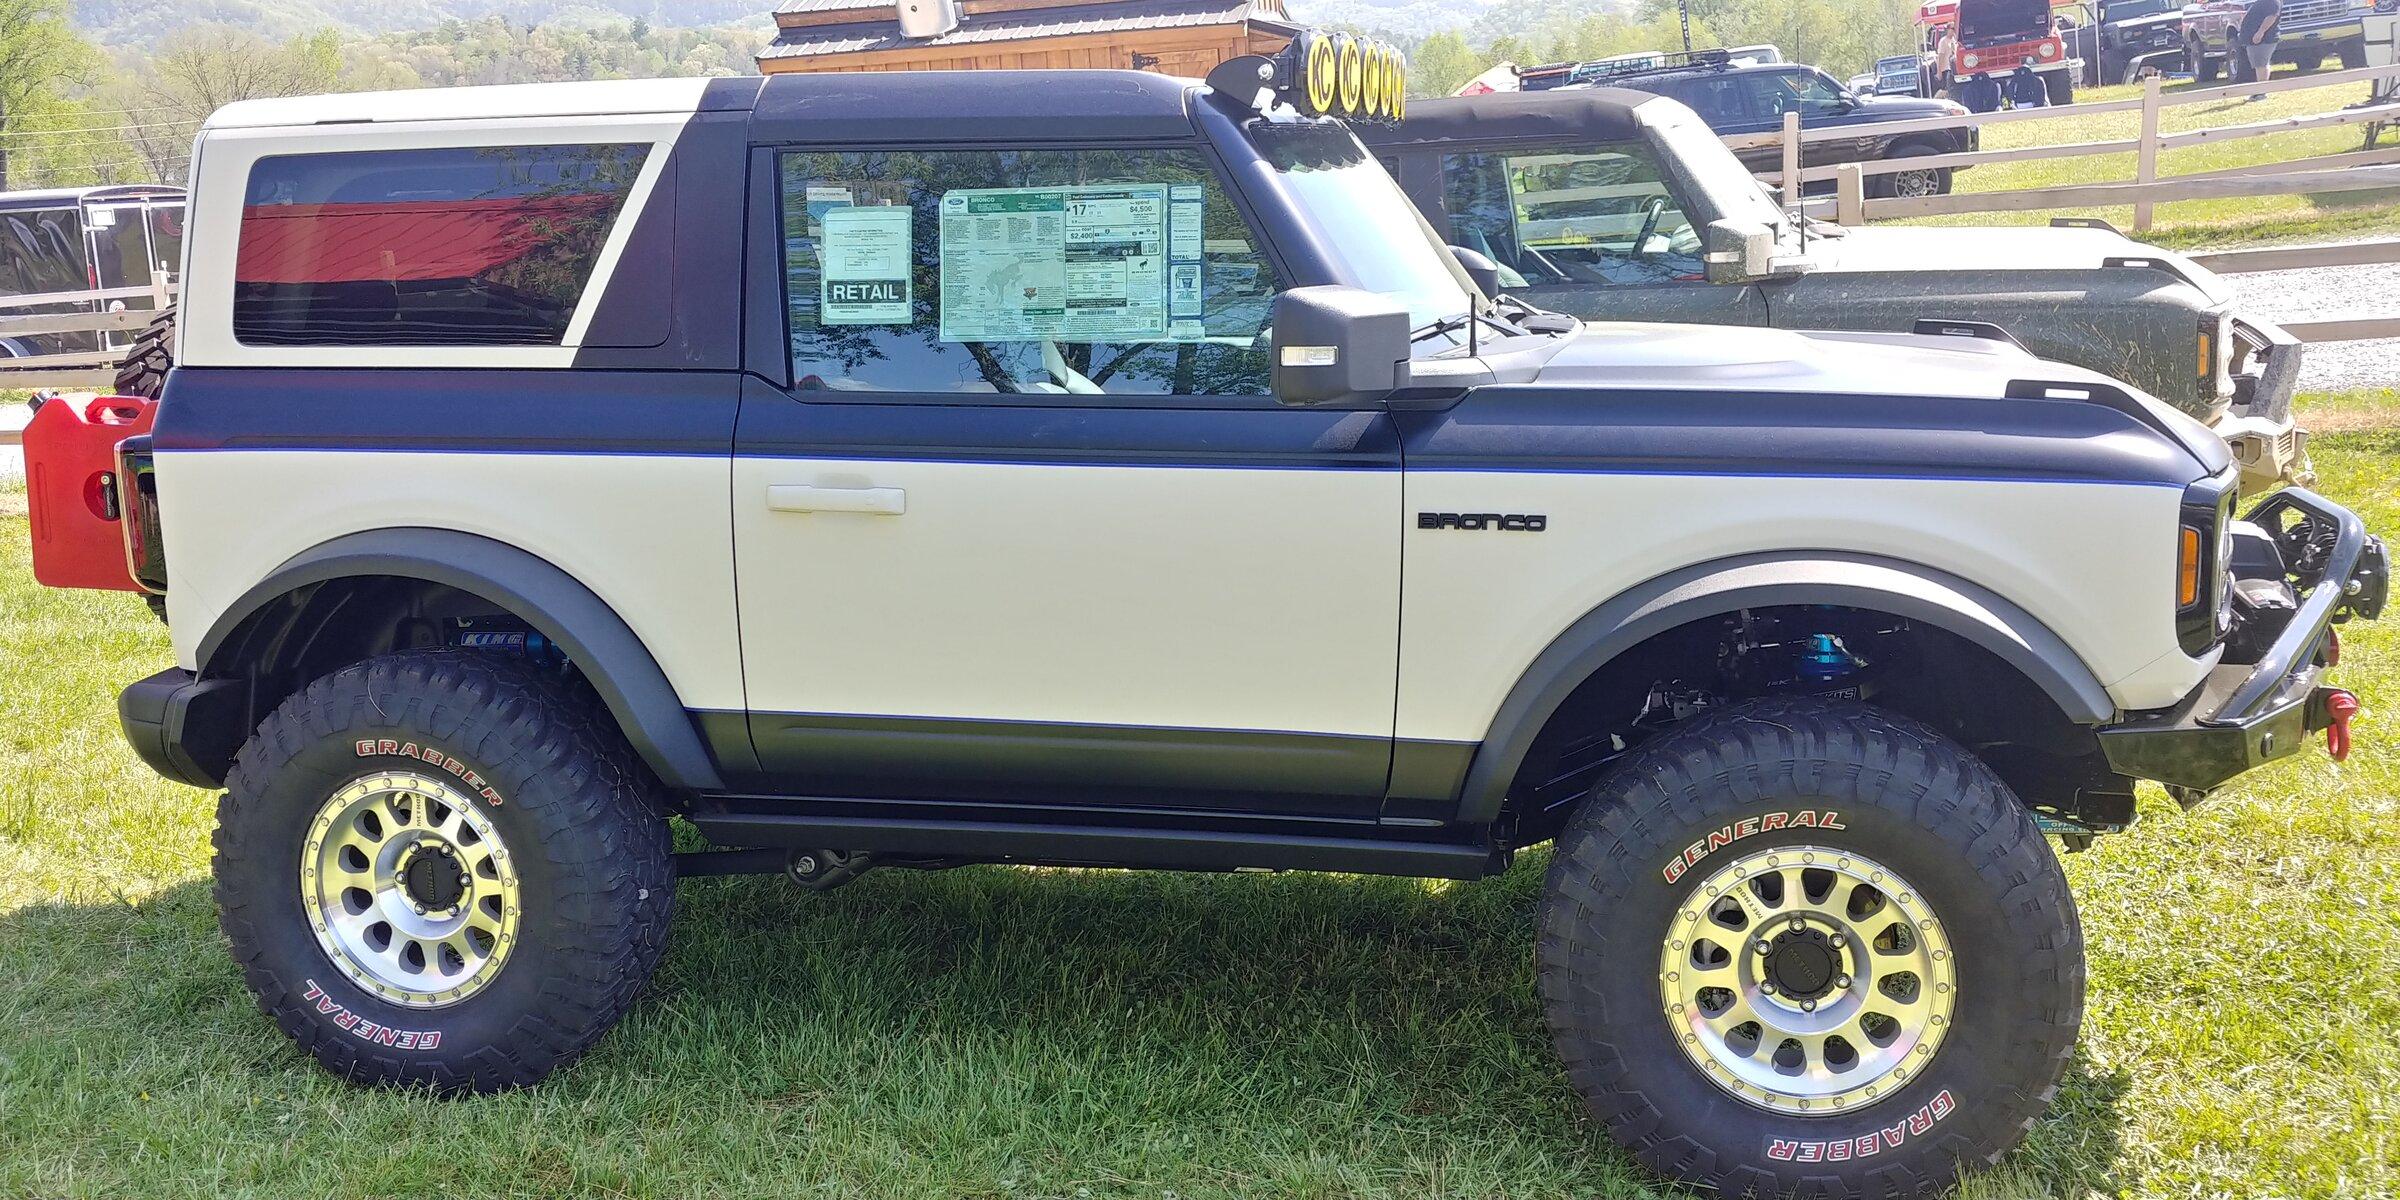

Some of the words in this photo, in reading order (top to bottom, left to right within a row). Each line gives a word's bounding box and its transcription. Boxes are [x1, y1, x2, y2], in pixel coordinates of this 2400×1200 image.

[1312, 42, 1331, 105] KC
[1343, 45, 1357, 105] KC
[1070, 232, 1093, 240] $2,400
[1072, 204, 1087, 216] 17
[1129, 205, 1153, 213] $4,500
[833, 284, 899, 300] RETAIL
[1417, 512, 1547, 532] BRONCO
[356, 739, 503, 807] GRABBER
[1662, 810, 1847, 885] GENERAL
[1735, 886, 1764, 920] METHOD
[303, 978, 442, 1050] GENERAL
[1767, 1089, 1956, 1162] GRABBER
